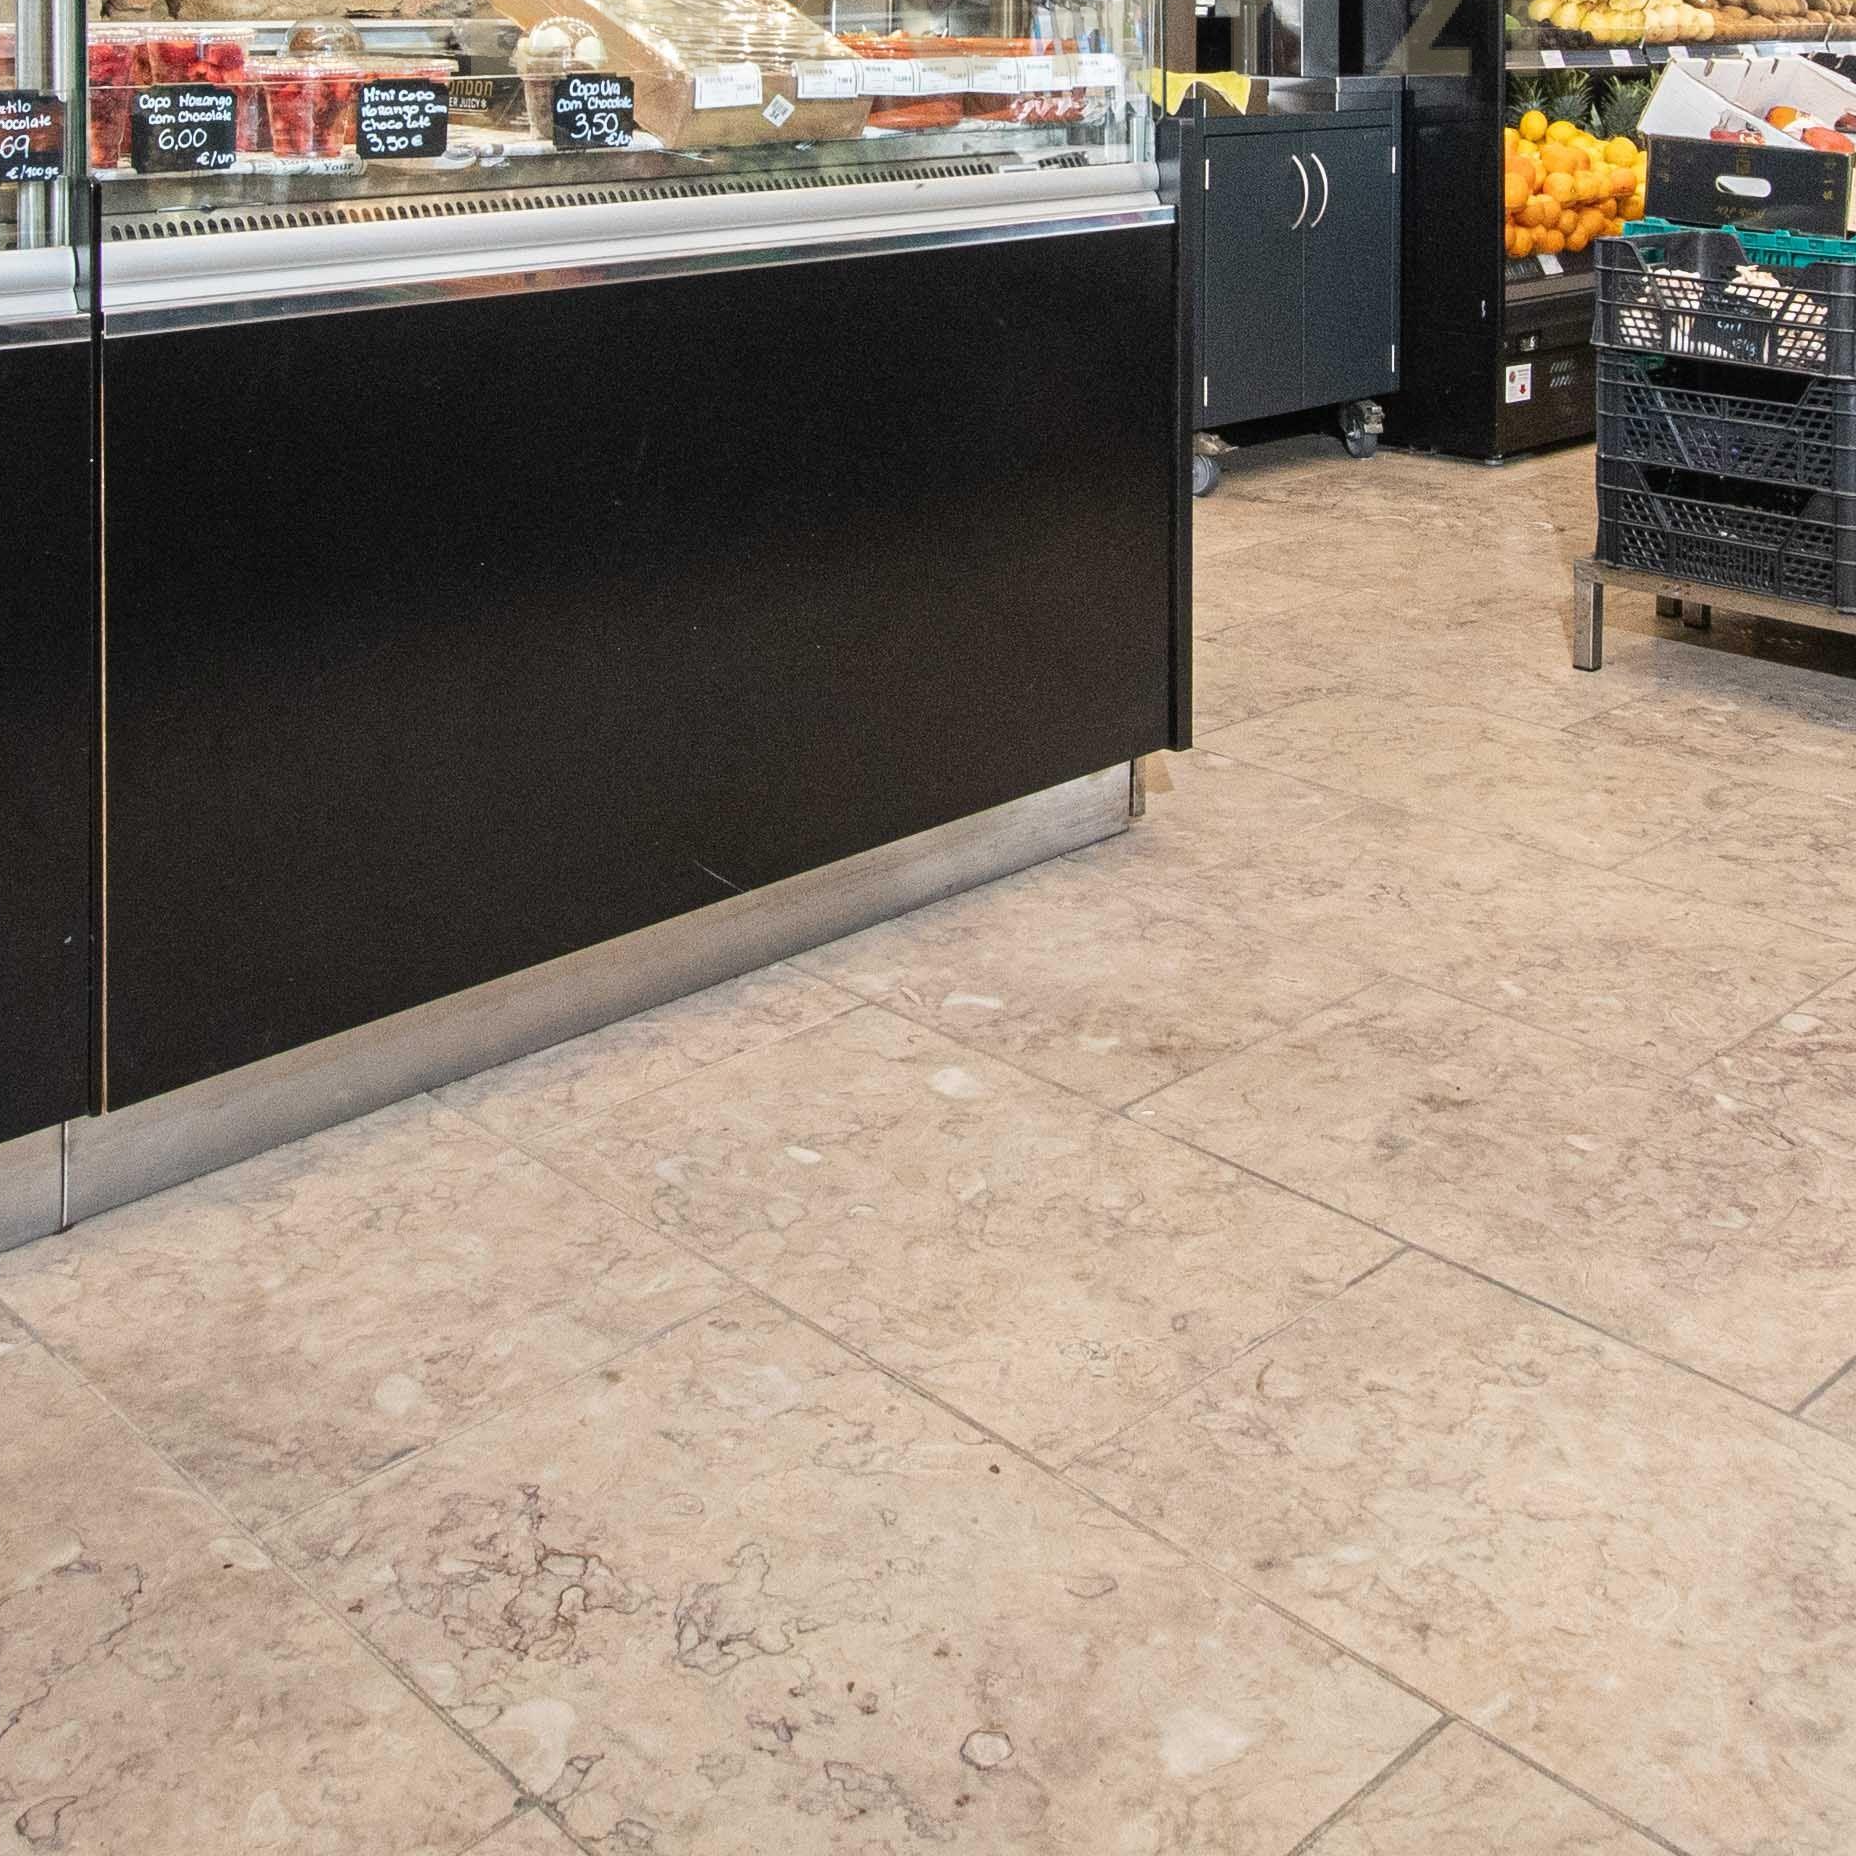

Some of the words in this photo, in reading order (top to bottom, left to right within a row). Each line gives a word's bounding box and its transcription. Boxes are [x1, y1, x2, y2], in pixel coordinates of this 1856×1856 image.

[570, 79, 597, 101] Copo
[139, 95, 171, 112] Copo
[557, 101, 582, 112] com
[148, 114, 176, 126] com
[178, 110, 232, 124] Chocolate
[571, 112, 618, 141] 3,50
[158, 128, 207, 151] 6,00
[196, 151, 236, 166] €/un
